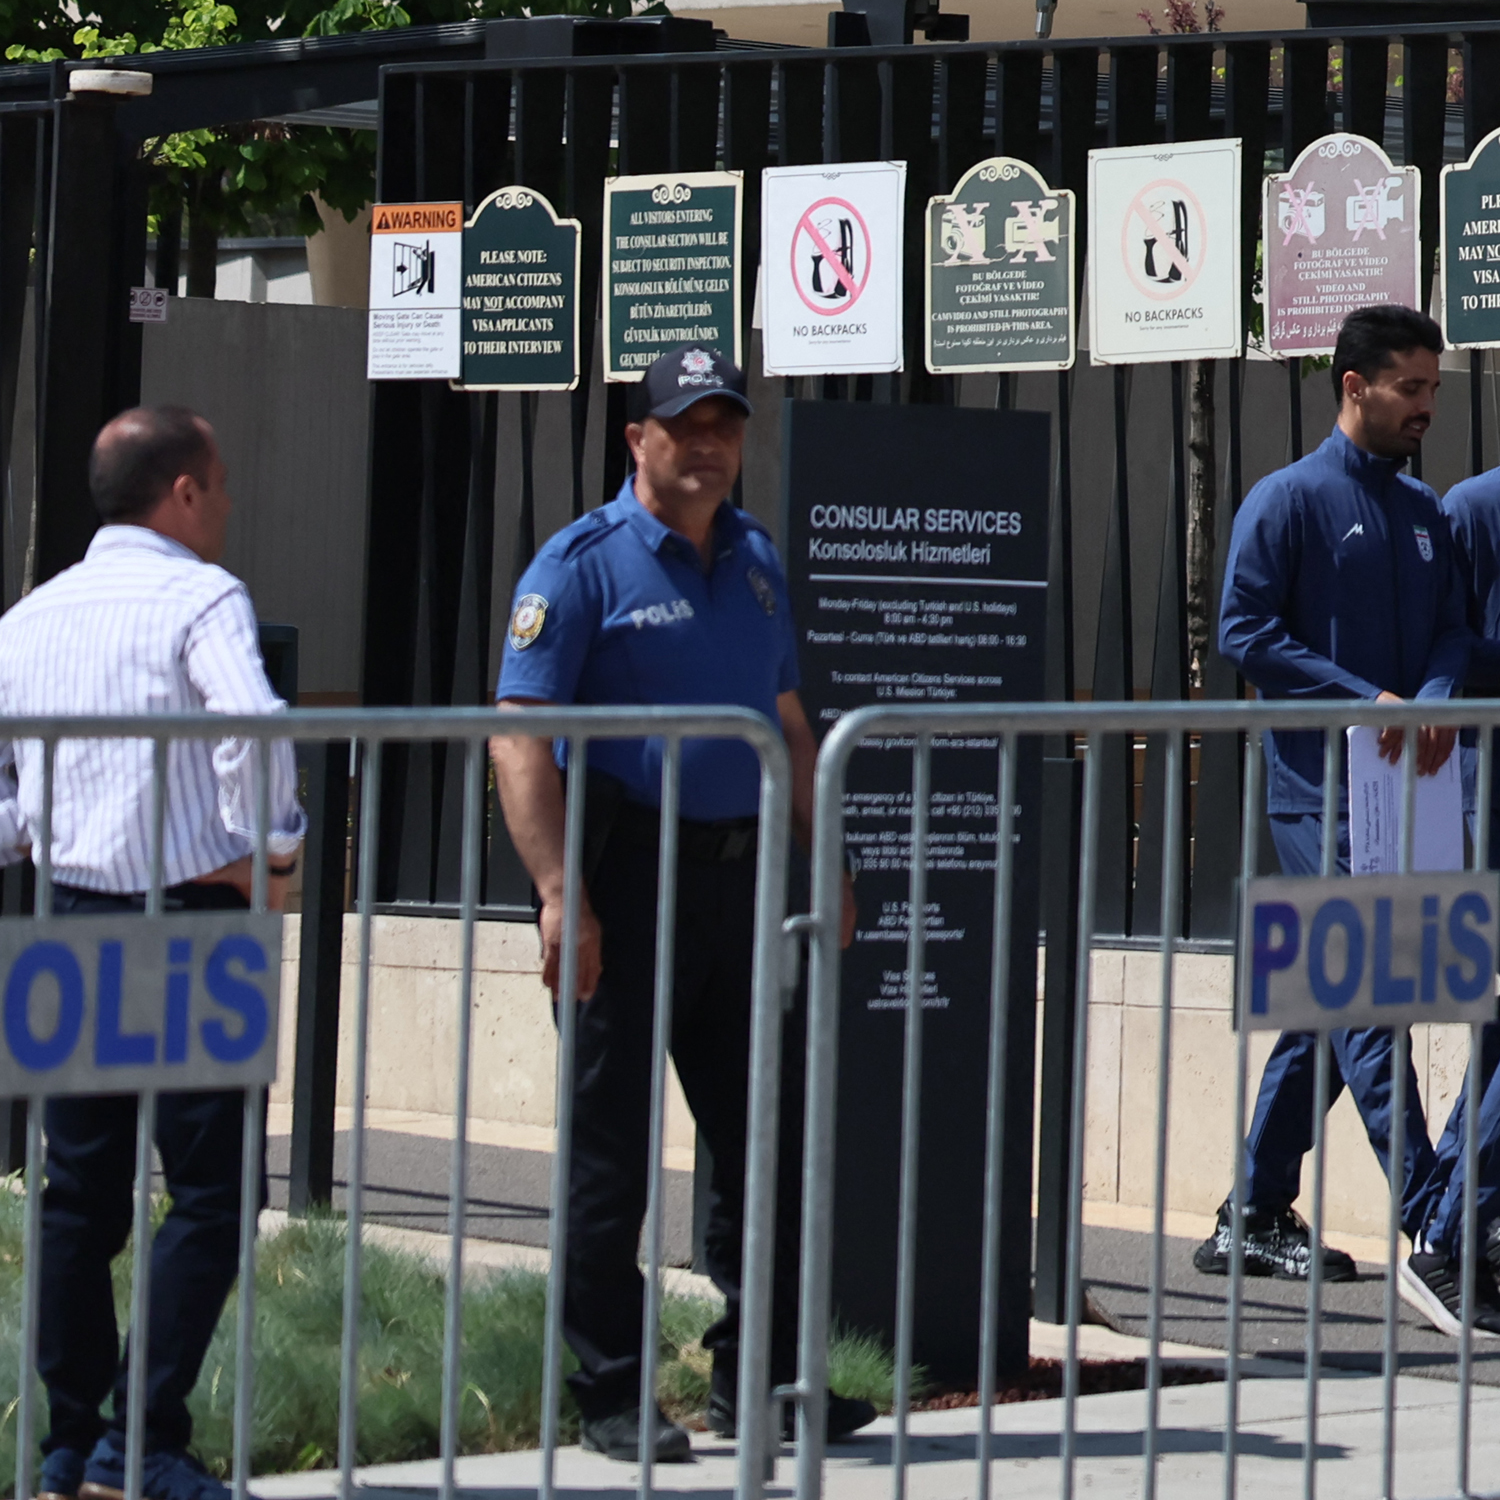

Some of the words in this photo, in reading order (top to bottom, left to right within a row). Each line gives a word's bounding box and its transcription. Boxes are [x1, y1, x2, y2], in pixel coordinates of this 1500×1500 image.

[391, 210, 456, 228] WARNING
[630, 212, 643, 225] ALL
[644, 210, 675, 224] VISITORS
[676, 208, 713, 223] ENTERING
[616, 236, 629, 249] THE
[630, 235, 667, 248] CONSULAR
[668, 233, 698, 247] SECTION
[698, 232, 717, 245] WILL
[718, 232, 728, 245] BE
[480, 251, 515, 264] PLEASE
[517, 250, 547, 263] NOTE:
[1312, 250, 1324, 258] BU
[1326, 247, 1370, 258] BÖLGEDE
[1458, 245, 1484, 261] MAY
[612, 260, 641, 273] SUBJECT
[641, 259, 652, 272] TO
[652, 257, 686, 272] SECURITY
[1294, 260, 1343, 270] FOTOĞRAF
[1345, 259, 1358, 267] VE
[1360, 256, 1388, 266] VİDEO
[972, 273, 984, 281] BU
[986, 270, 1027, 280] BÖLGEDE
[1334, 267, 1383, 278] YASAKTIR!
[1473, 270, 1500, 284] VISA
[465, 273, 516, 287] AMERICAN
[517, 273, 562, 286] CITIZENS
[705, 279, 730, 292] GELEN
[1003, 282, 1015, 291] VE
[1316, 284, 1344, 293] VIDEO
[1346, 283, 1366, 292] AND
[463, 296, 482, 310] MAY
[483, 296, 504, 310] NOT
[505, 295, 565, 309] ACCOMPANY
[994, 292, 1040, 302] YASAKTIR!
[1292, 296, 1318, 305] STILL
[1320, 292, 1390, 304] PHOTOGRAPHY
[1461, 295, 1478, 310] TO
[973, 310, 988, 320] AND
[989, 309, 1011, 319] STILL
[1012, 307, 1068, 317] PHOTOGRAPHY
[1125, 311, 1142, 323] NO
[1145, 307, 1203, 322] BACKPACKS
[1277, 308, 1285, 316] IS
[1287, 305, 1342, 316] PROHIBITED
[1344, 305, 1354, 313] IN
[472, 319, 494, 332] VISA
[495, 318, 554, 331] APPLICANTS
[793, 326, 808, 337] NO
[811, 323, 867, 336] BACKPACKS
[947, 325, 954, 333] IS
[955, 323, 1001, 333] PROHIBITED
[1030, 321, 1053, 329] AREA.
[464, 342, 476, 355] TO
[478, 341, 507, 354] THEIR
[508, 340, 563, 354] INTERVIEW
[810, 504, 919, 532] CONSULAR
[924, 509, 1022, 535] SERVICES
[809, 538, 908, 562] Konsolosluk
[911, 541, 991, 565] Hizmetleri
[4, 934, 270, 1072] OLİS
